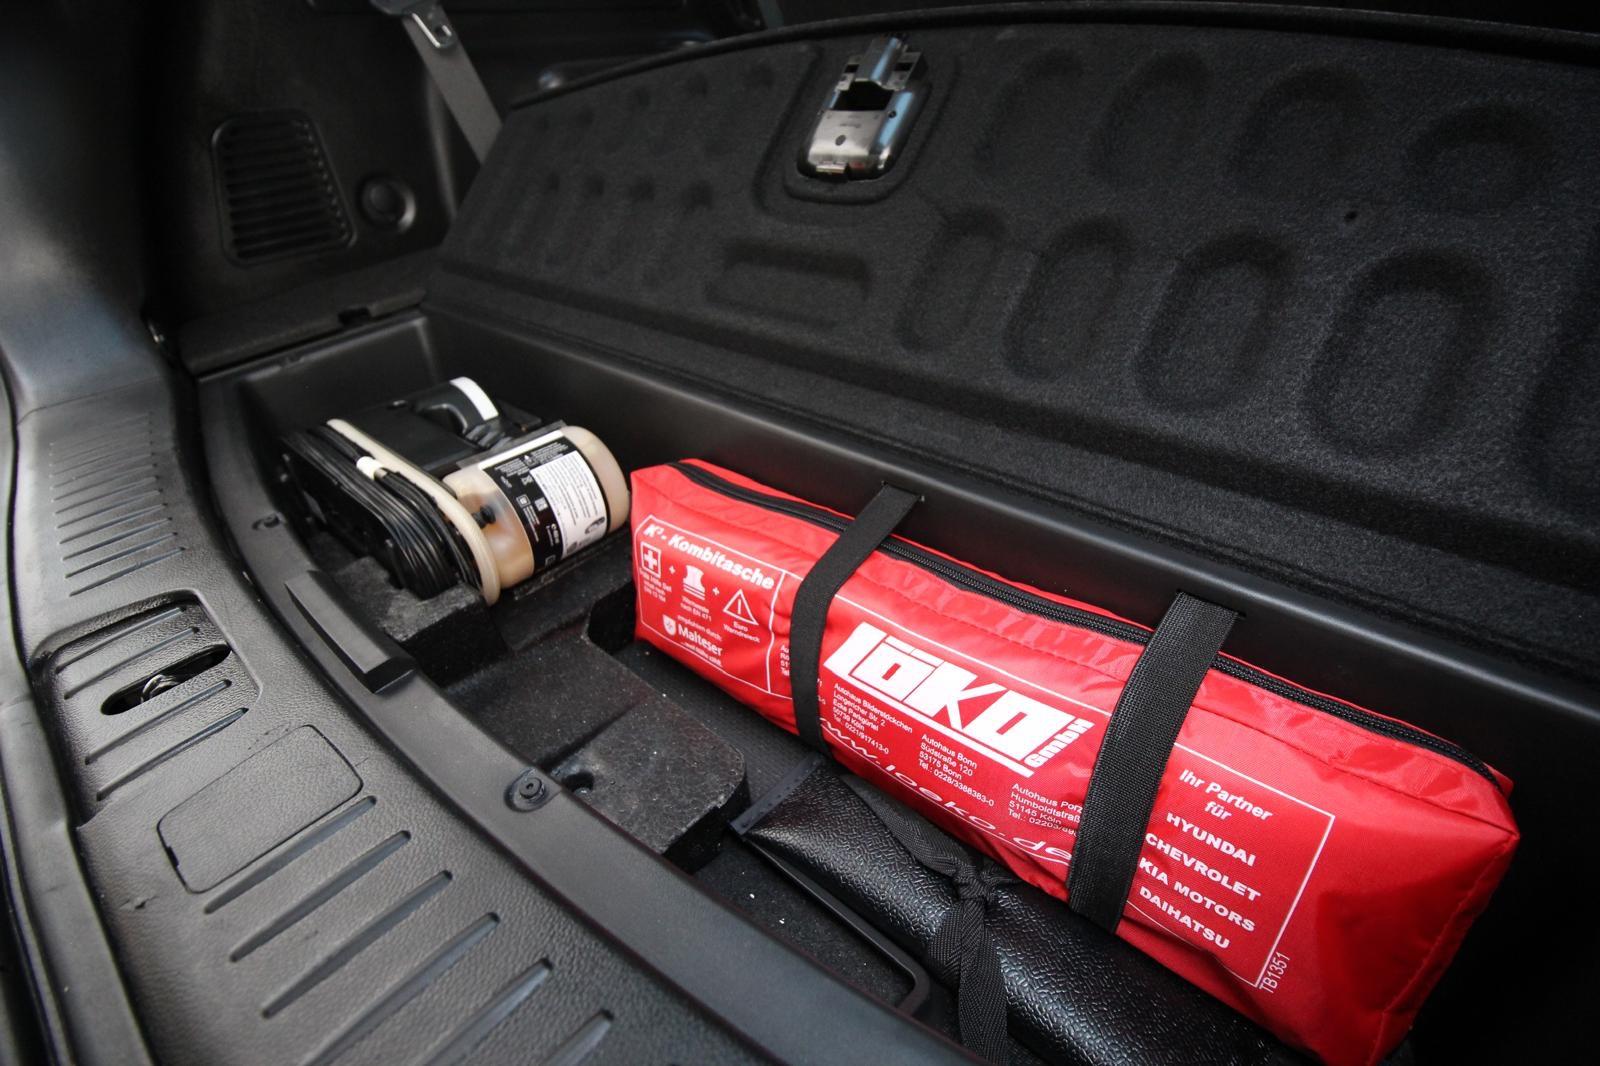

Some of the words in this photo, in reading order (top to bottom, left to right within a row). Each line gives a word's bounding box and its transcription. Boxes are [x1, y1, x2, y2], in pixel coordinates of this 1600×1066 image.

[668, 534, 775, 589] Kombitasche
[678, 624, 722, 656] Malteser
[920, 742, 957, 767] Südstraße
[959, 764, 973, 776] 120
[921, 734, 956, 757] Autohaus
[957, 752, 978, 769] Bonn
[1024, 718, 1095, 768] GmbH
[919, 750, 942, 768] 53175
[942, 764, 962, 780] Bonn
[1008, 800, 1037, 817] 51145
[1040, 812, 1062, 825] Köln
[1010, 791, 1081, 824] Humboldtstraß
[1012, 783, 1058, 807] Autohaus
[1179, 769, 1205, 788] Ihr
[1205, 782, 1273, 820] Partner
[1204, 801, 1232, 821] für
[1166, 812, 1257, 867] HYUNDAI
[1145, 833, 1261, 901] CHEVROLET
[1139, 857, 1169, 886] KIA
[1174, 881, 1256, 932] MOTORS
[1139, 886, 1231, 949] DAIHATSU
[1259, 951, 1291, 994] TB1351
